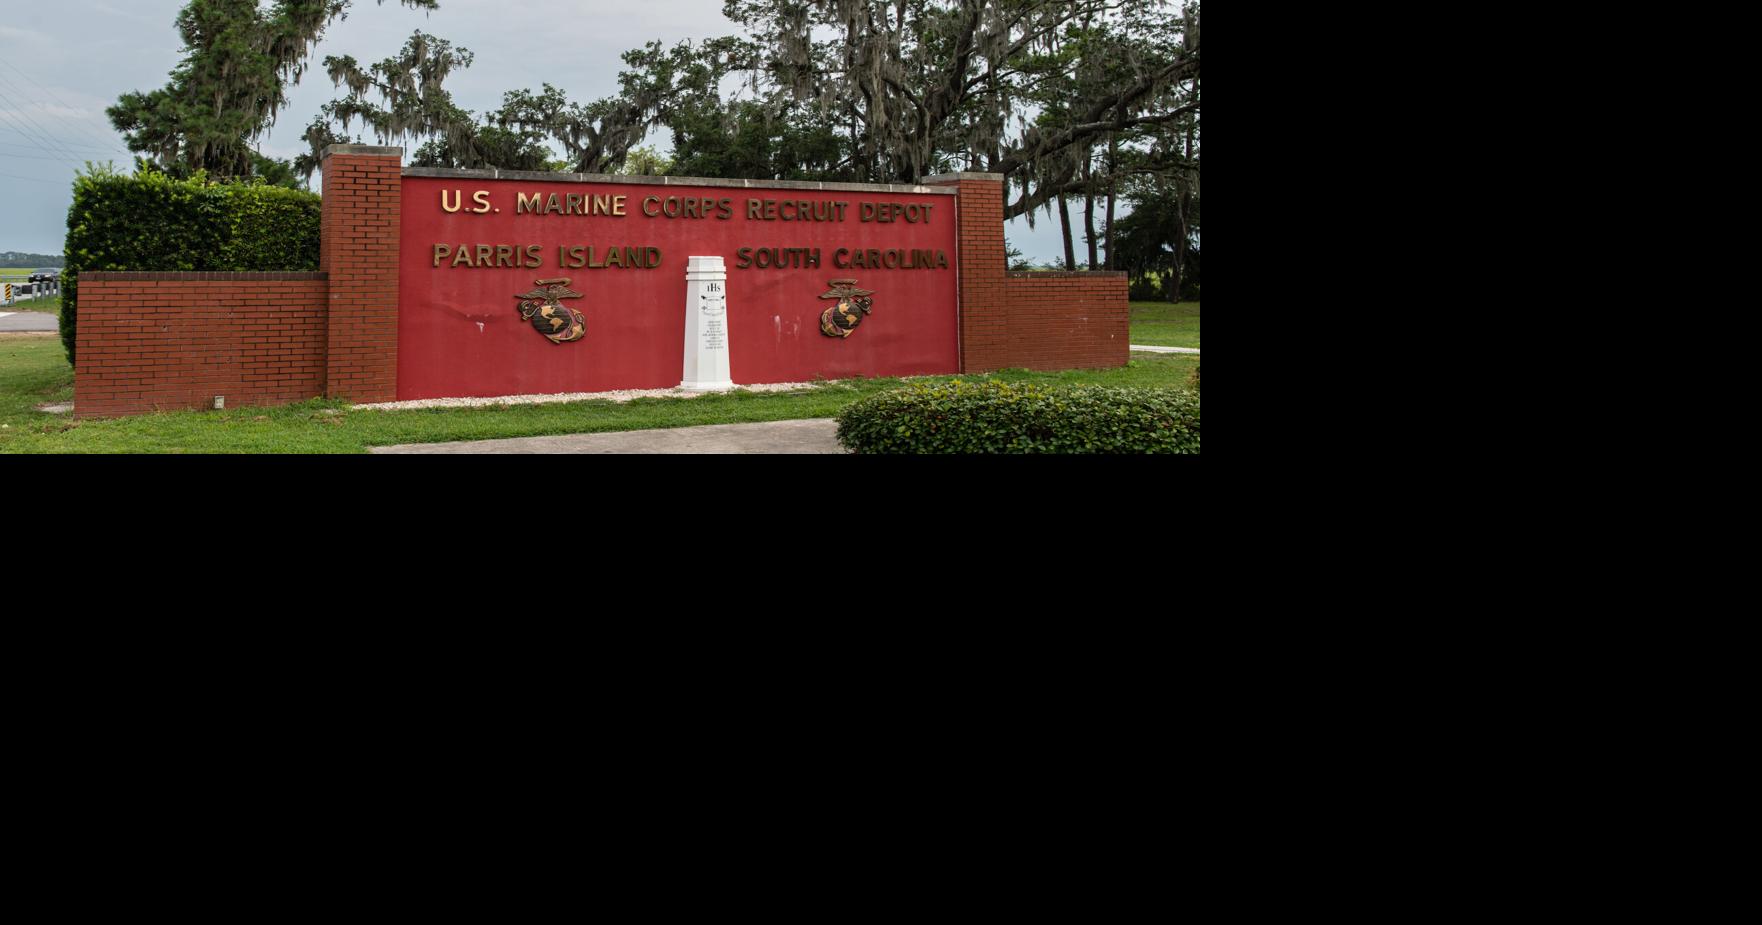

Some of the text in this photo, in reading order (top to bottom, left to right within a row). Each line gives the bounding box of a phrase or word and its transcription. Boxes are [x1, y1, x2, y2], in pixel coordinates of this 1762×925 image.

[440, 189, 933, 224] U.S. MARINE CORPS RECRUIT DEPOT
[433, 244, 949, 269] PARRIS ISLAND SOUTH CAROLINA
